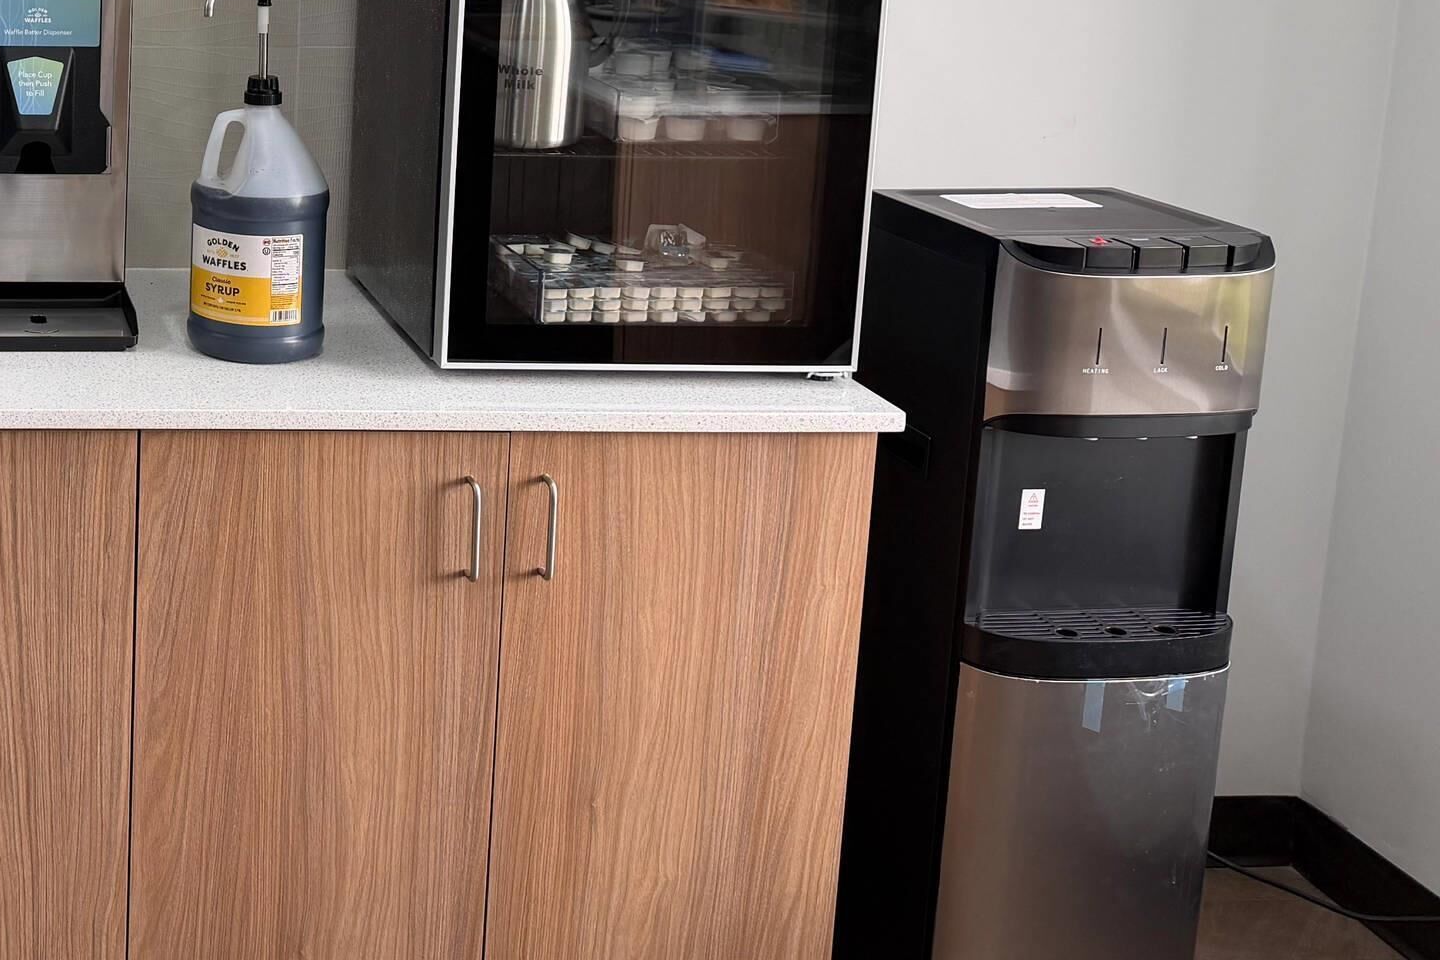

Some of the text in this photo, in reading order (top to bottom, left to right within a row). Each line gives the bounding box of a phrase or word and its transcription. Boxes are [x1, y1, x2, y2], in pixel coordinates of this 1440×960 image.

[3, 28, 73, 37] Waffle Batter Dispenser
[18, 71, 53, 80] Place Cup
[498, 64, 544, 76] Whole
[504, 79, 535, 90] Milk
[25, 89, 45, 97] to Fill
[207, 238, 240, 252] GOLDEN
[202, 254, 247, 271] WAFFLES
[205, 282, 240, 297] SYRUP
